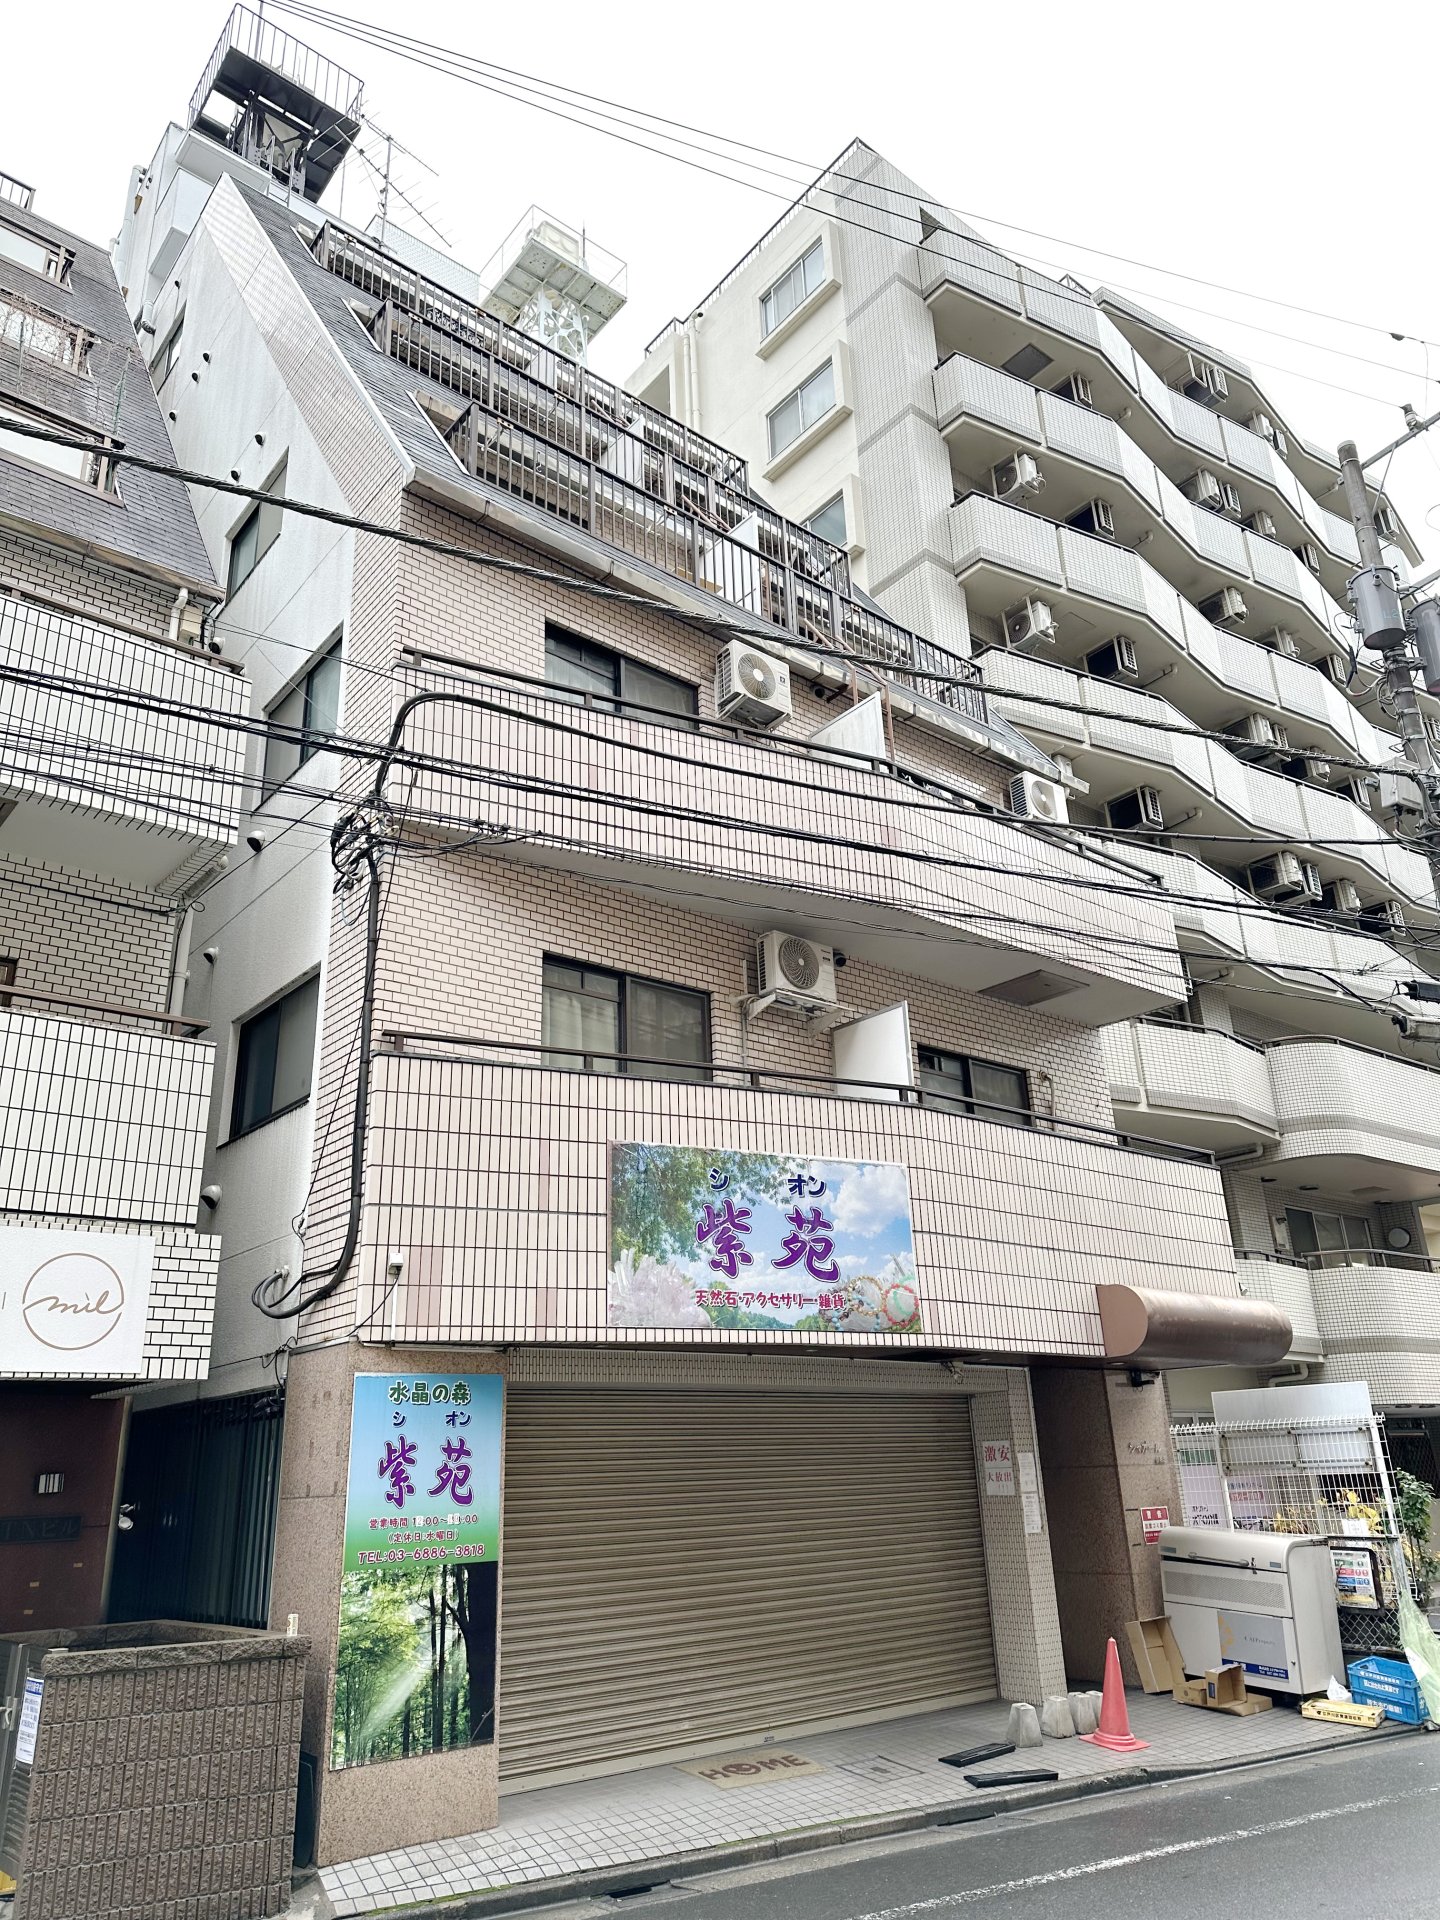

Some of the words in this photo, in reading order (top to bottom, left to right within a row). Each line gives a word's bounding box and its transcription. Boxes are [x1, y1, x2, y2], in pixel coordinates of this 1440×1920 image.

[388, 1381, 471, 1405] 水晶の森
[984, 1445, 1010, 1462] 激安
[987, 1471, 1012, 1482] 大放出
[369, 1517, 408, 1529] 営業時間
[698, 1754, 810, 1781] HOME
